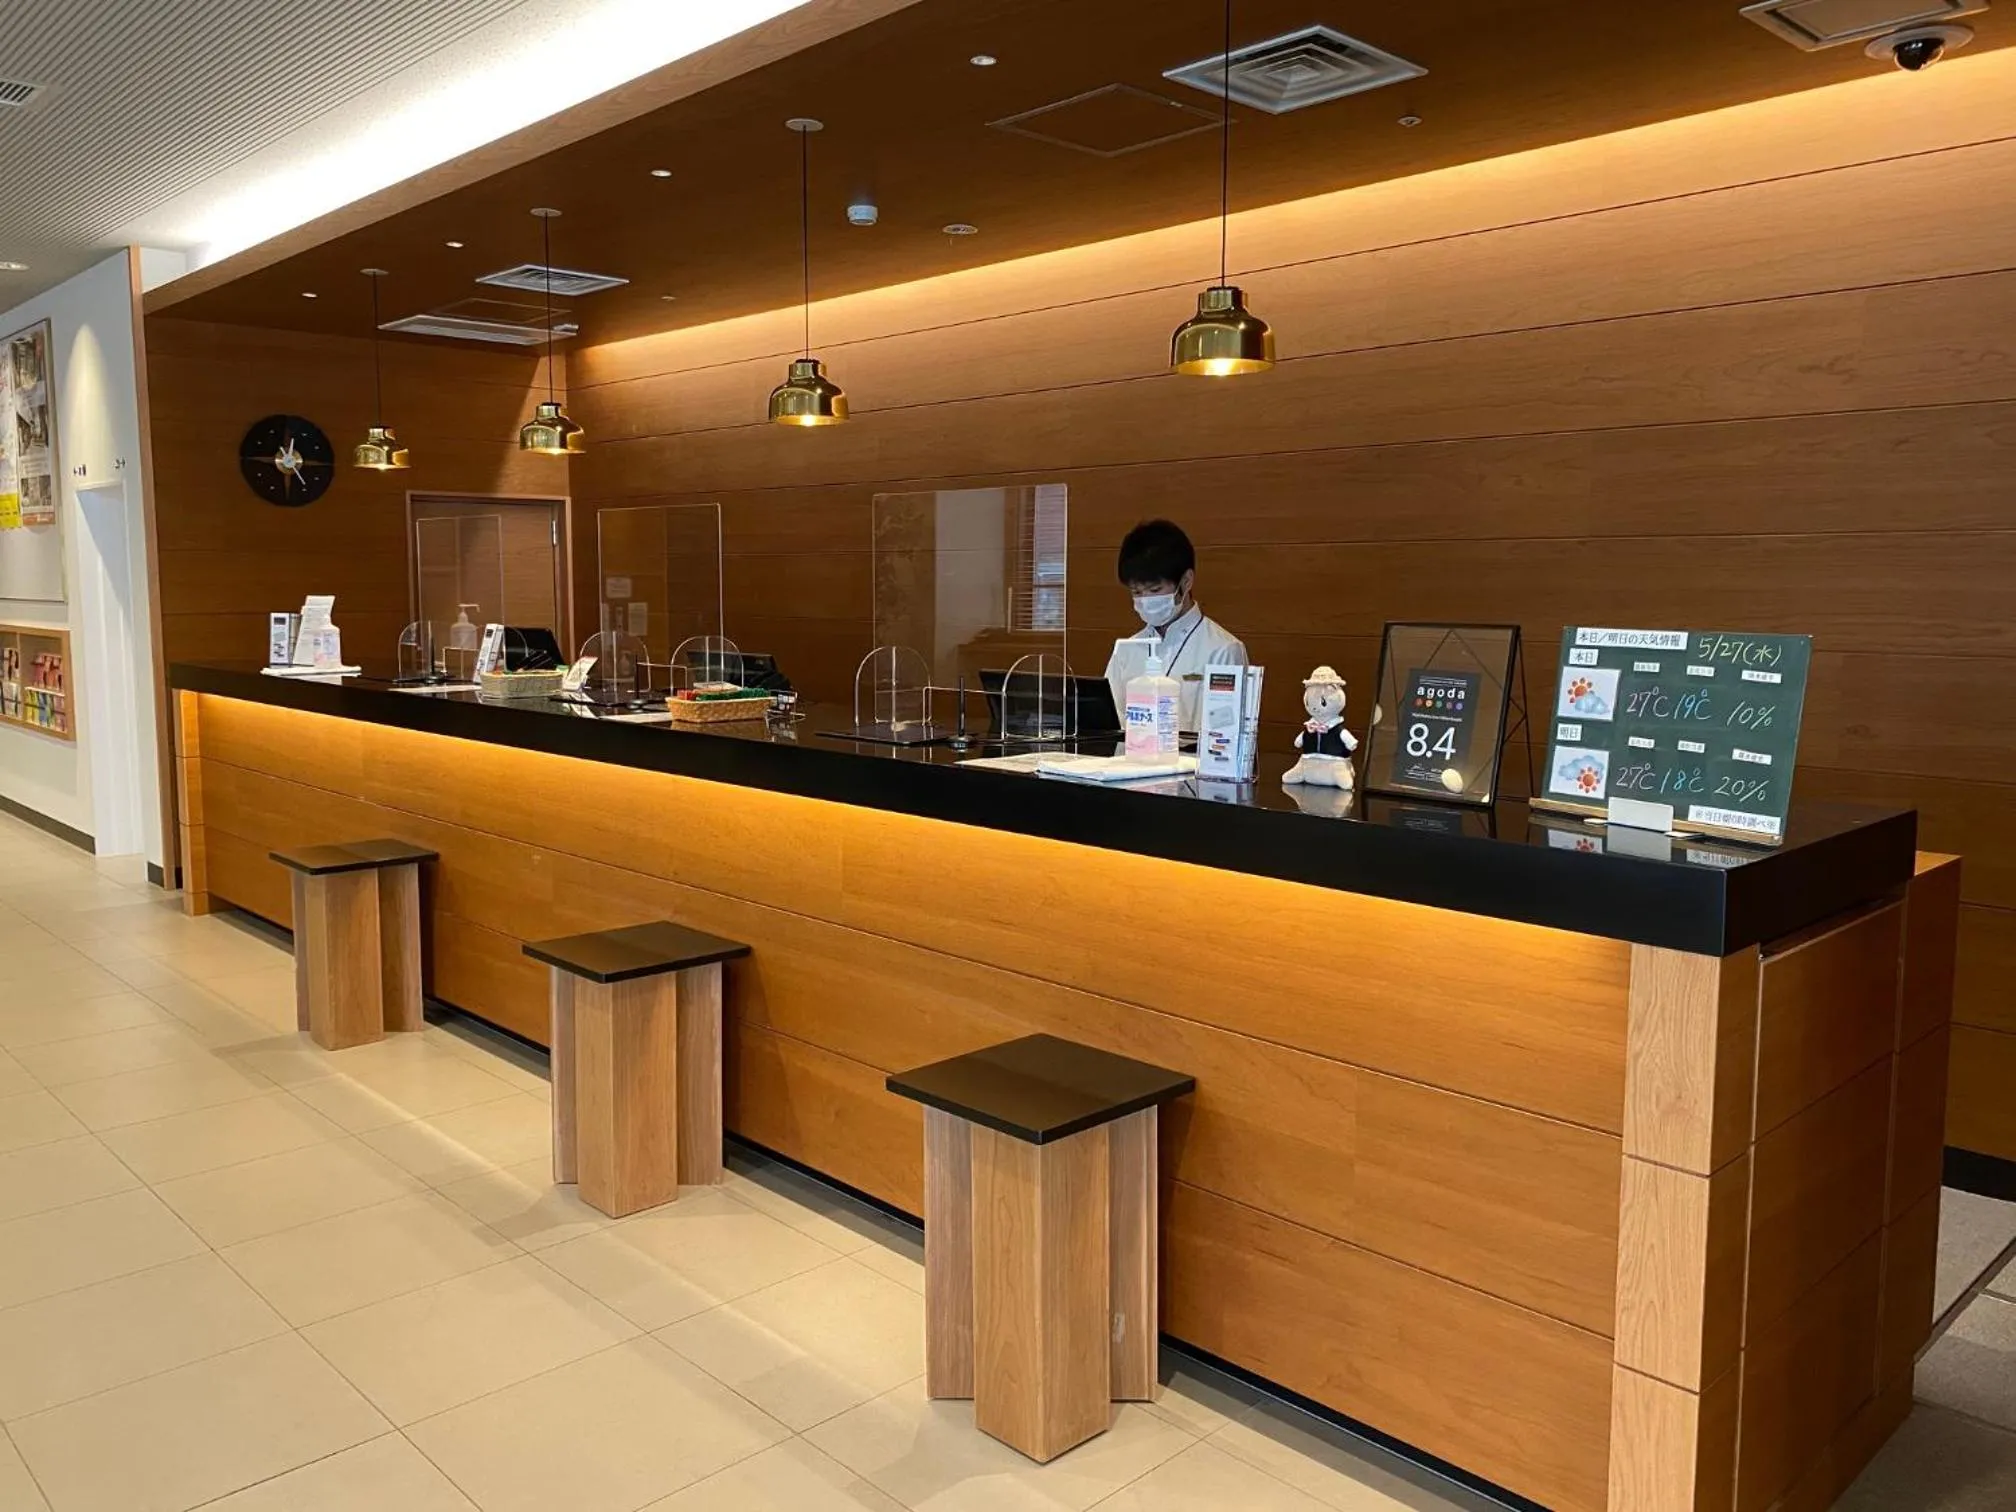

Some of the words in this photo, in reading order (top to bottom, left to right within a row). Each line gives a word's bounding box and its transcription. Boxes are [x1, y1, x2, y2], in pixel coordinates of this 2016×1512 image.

[1575, 652, 1594, 664] 本日
[1699, 634, 1782, 667] 5/27(水)
[1417, 686, 1466, 699] agoda
[1726, 701, 1776, 730] 10%
[1406, 722, 1457, 761] 8.4
[1559, 726, 1579, 739] 明日
[1713, 776, 1770, 803] 20%
